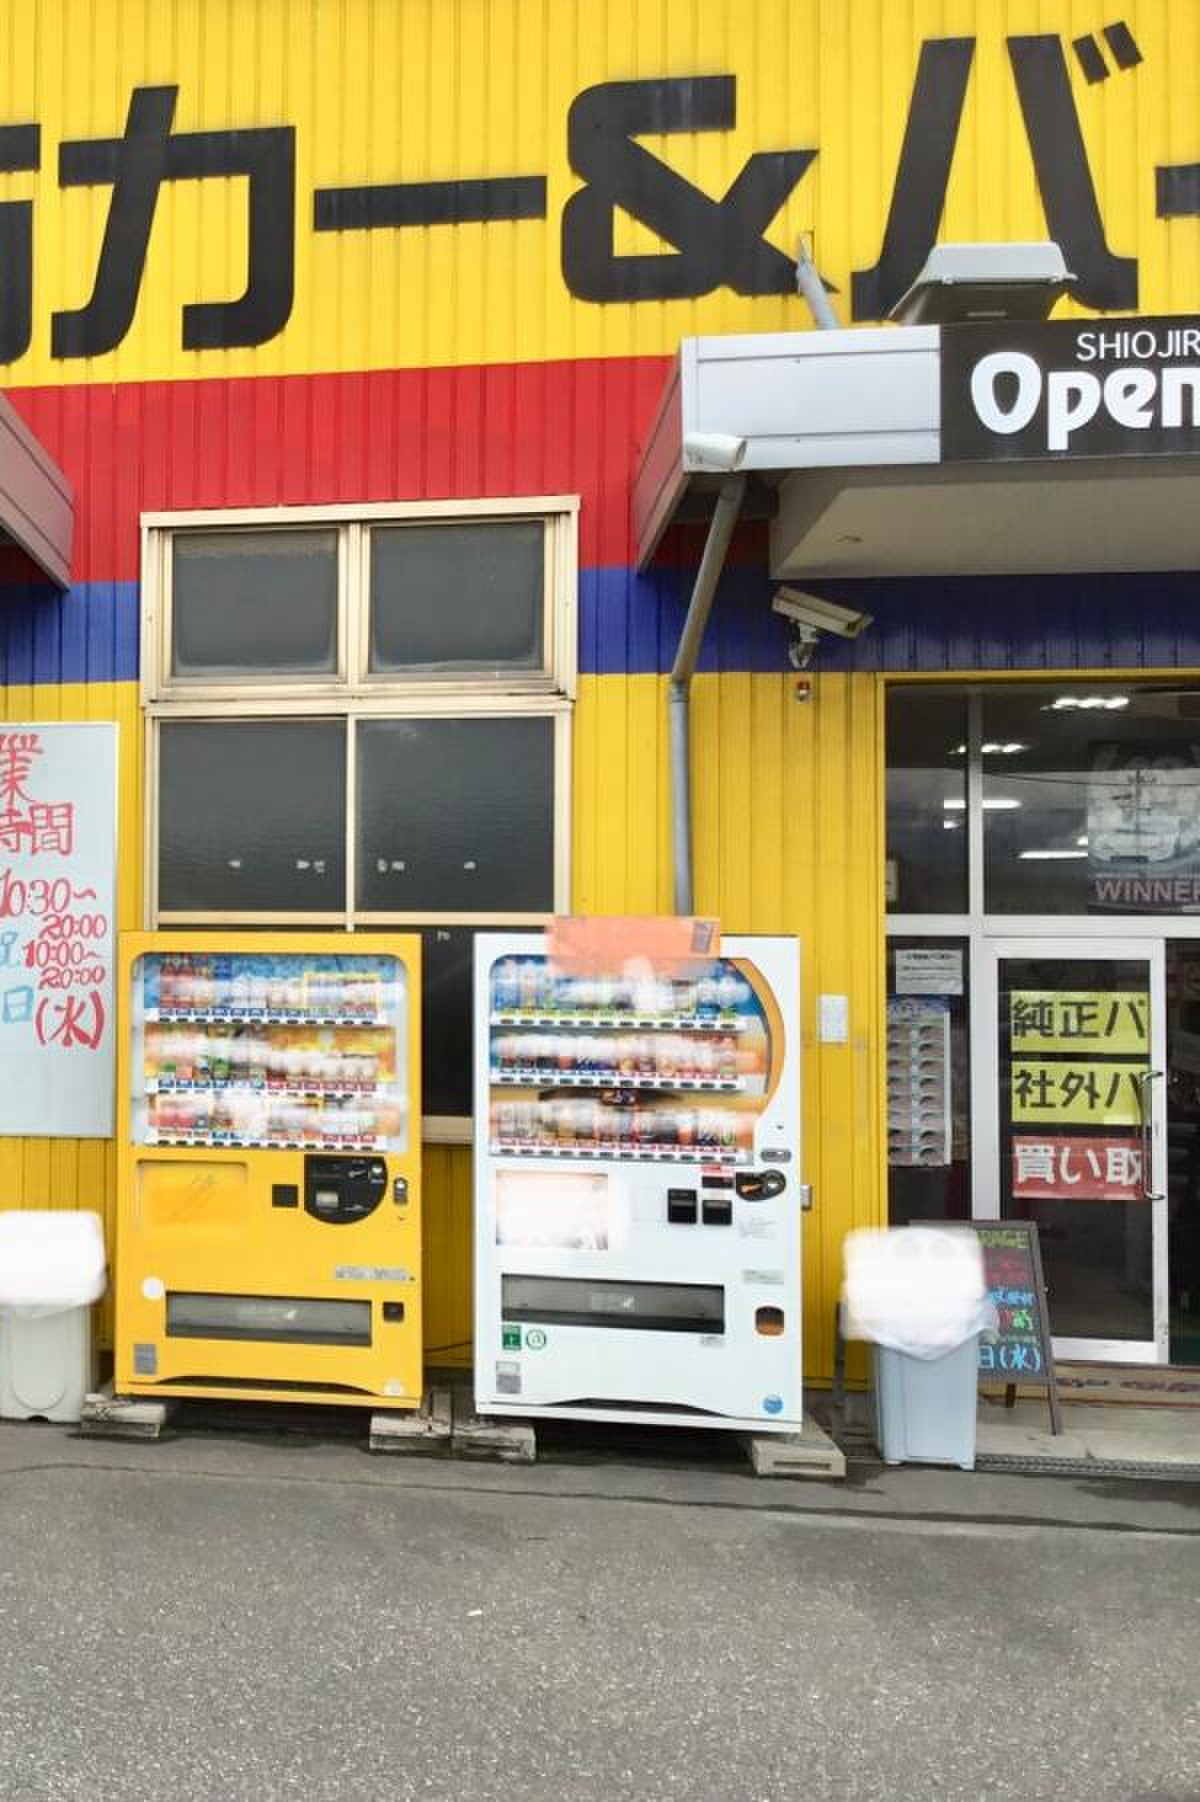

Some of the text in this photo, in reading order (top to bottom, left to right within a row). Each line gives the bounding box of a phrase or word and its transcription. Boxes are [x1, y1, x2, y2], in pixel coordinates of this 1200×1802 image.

[1076, 329, 1200, 361] SHIOJIR
[971, 352, 1200, 451] Open
[1095, 879, 1200, 902] WINNE
[39, 914, 107, 940] 20:00
[38, 965, 106, 990] 20:00
